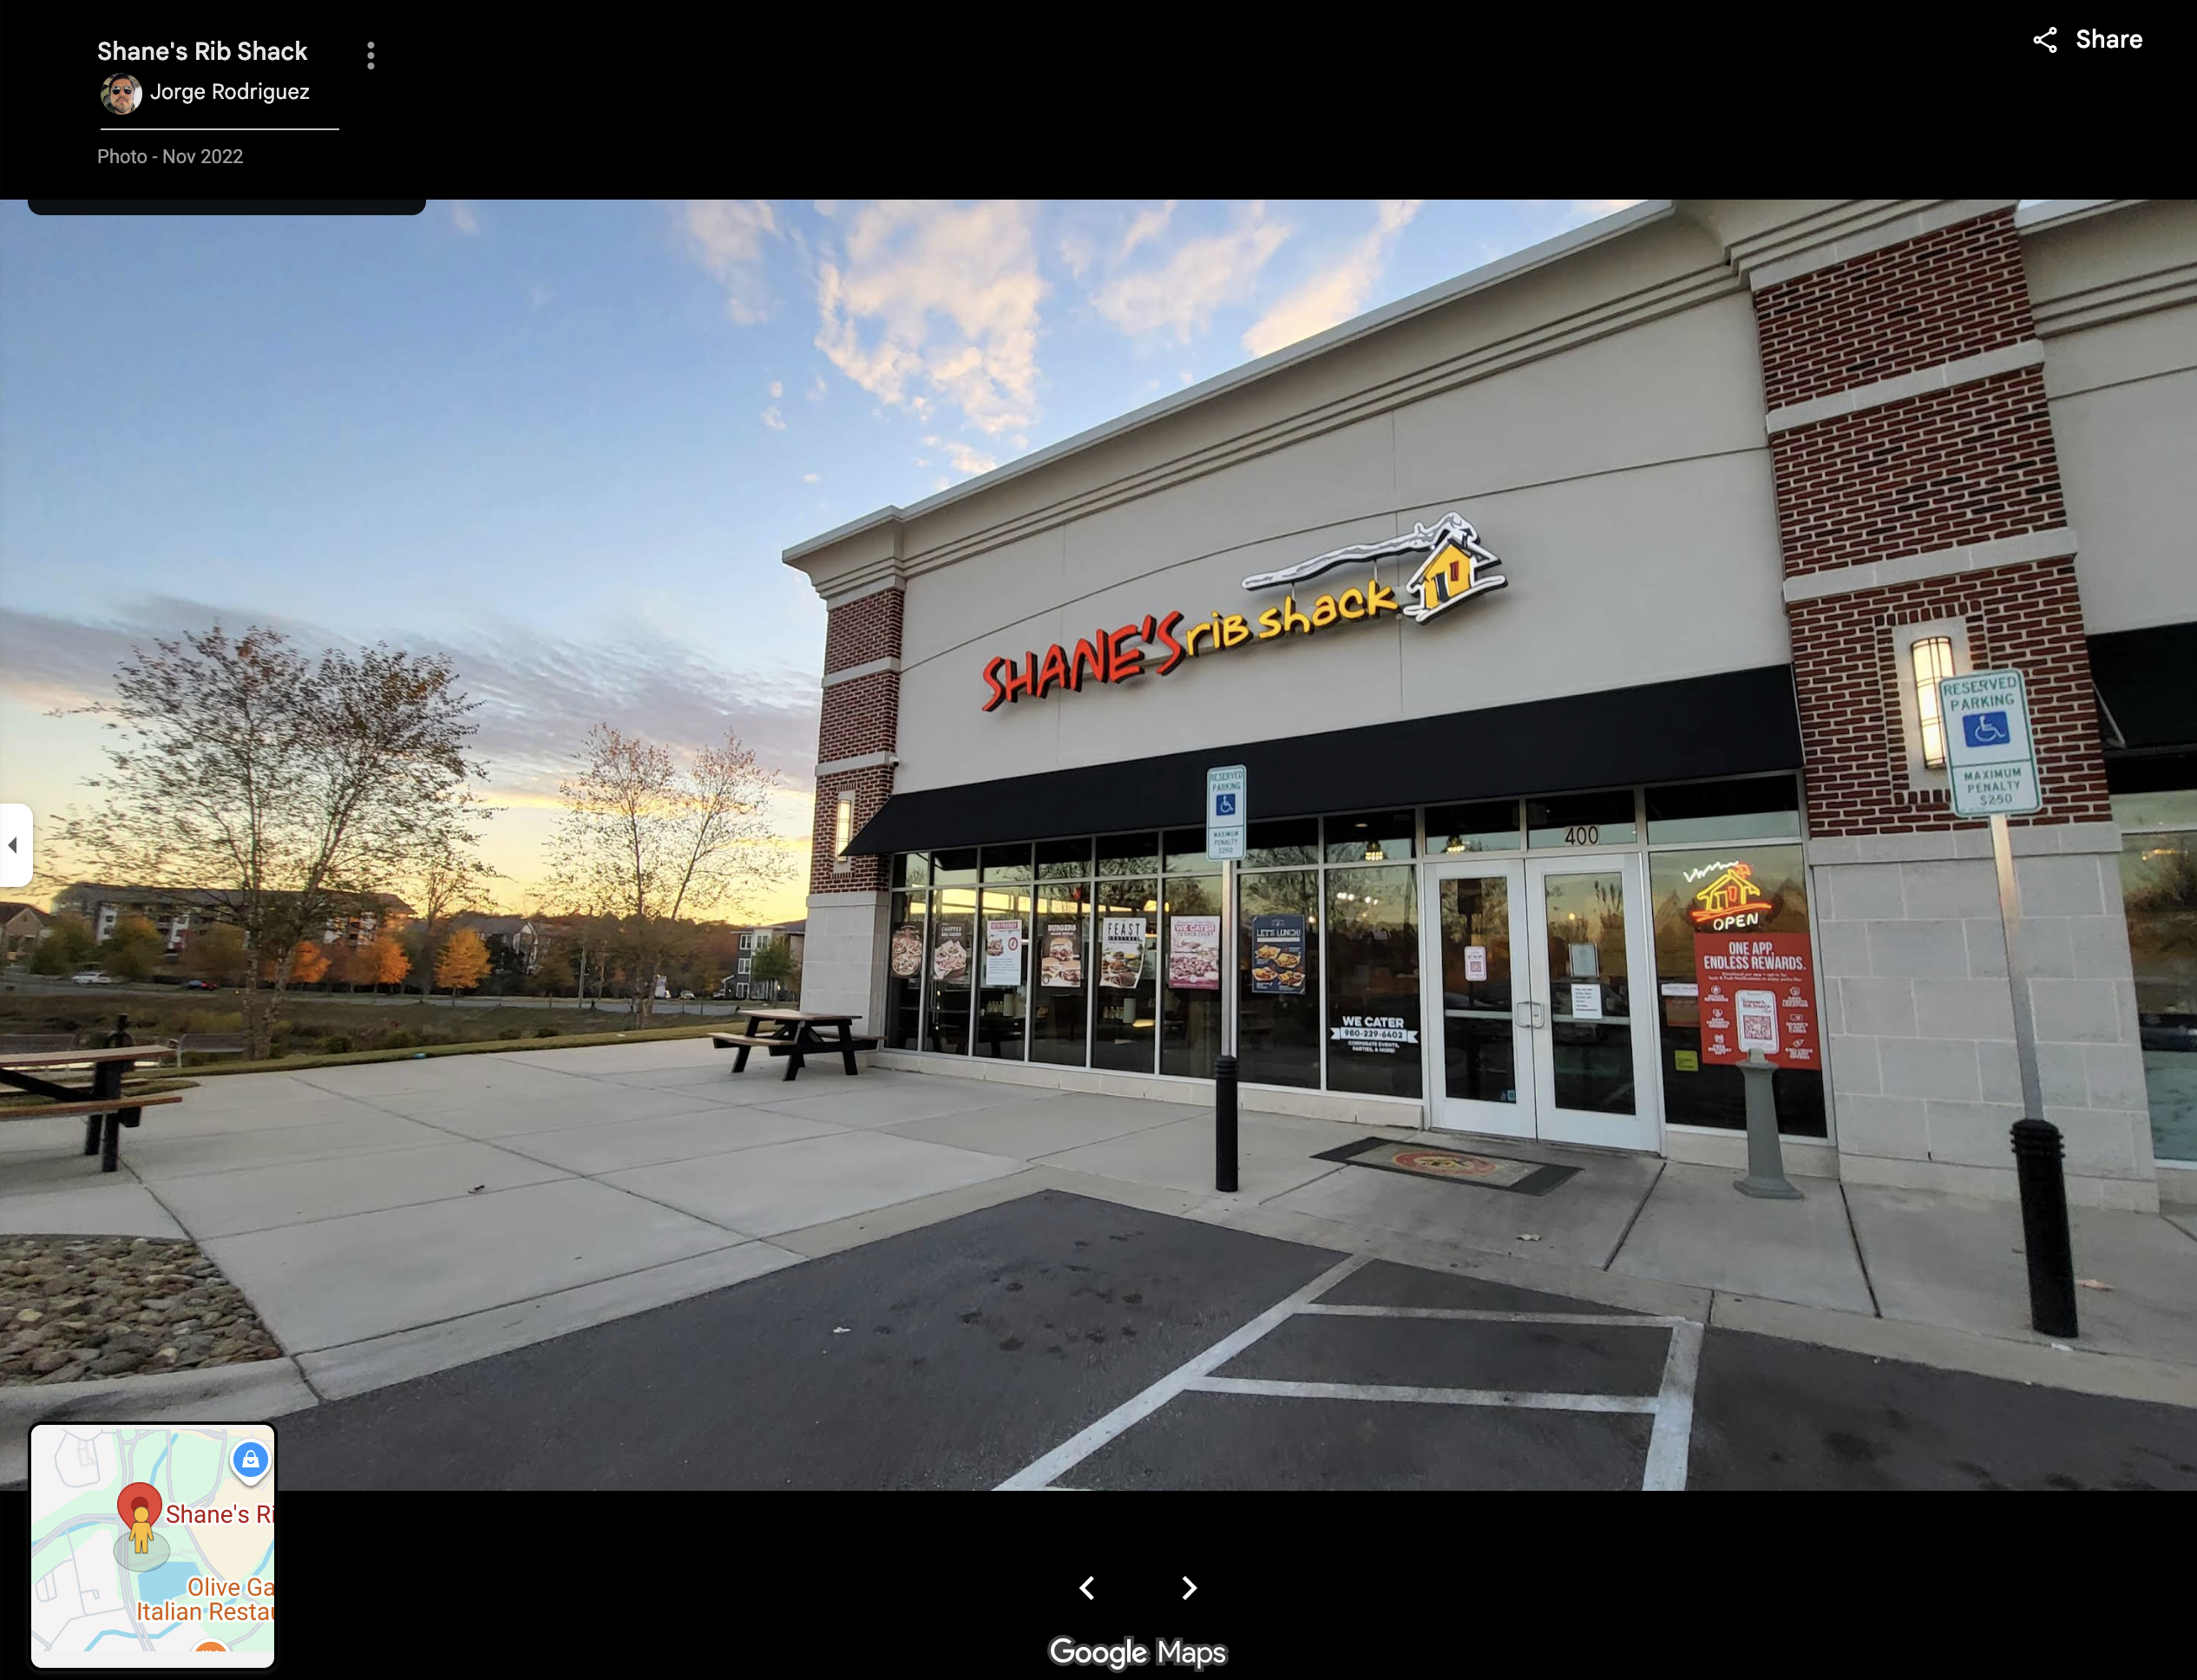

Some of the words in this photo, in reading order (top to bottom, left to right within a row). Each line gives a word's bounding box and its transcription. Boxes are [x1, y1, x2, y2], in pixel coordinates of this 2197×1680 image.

[981, 609, 1186, 712] SHANE'S
[1258, 579, 1399, 639] shack
[1943, 676, 2017, 697] RESERVED
[1951, 693, 2015, 712] PARKING
[1210, 771, 1243, 781] RESERVED
[1964, 768, 2022, 781] MAXIMUM
[1212, 782, 1241, 791] PARKING
[1967, 781, 2021, 794] PENALTY
[1980, 793, 2012, 806] $250
[1564, 825, 1598, 846] 400
[1047, 923, 1077, 932] BURGERS
[1713, 912, 1760, 931] OPEN
[1108, 922, 1140, 935] FEAST
[1256, 929, 1276, 937] LET'S
[1728, 941, 1750, 955] ONE
[1752, 942, 1775, 957] APP,
[1703, 955, 1750, 970] ENDLESS
[1751, 955, 1807, 971] REWARDS.
[1341, 1015, 1362, 1027] WE
[1364, 1016, 1405, 1028] CATER
[1344, 1028, 1403, 1039] 980-229-6402
